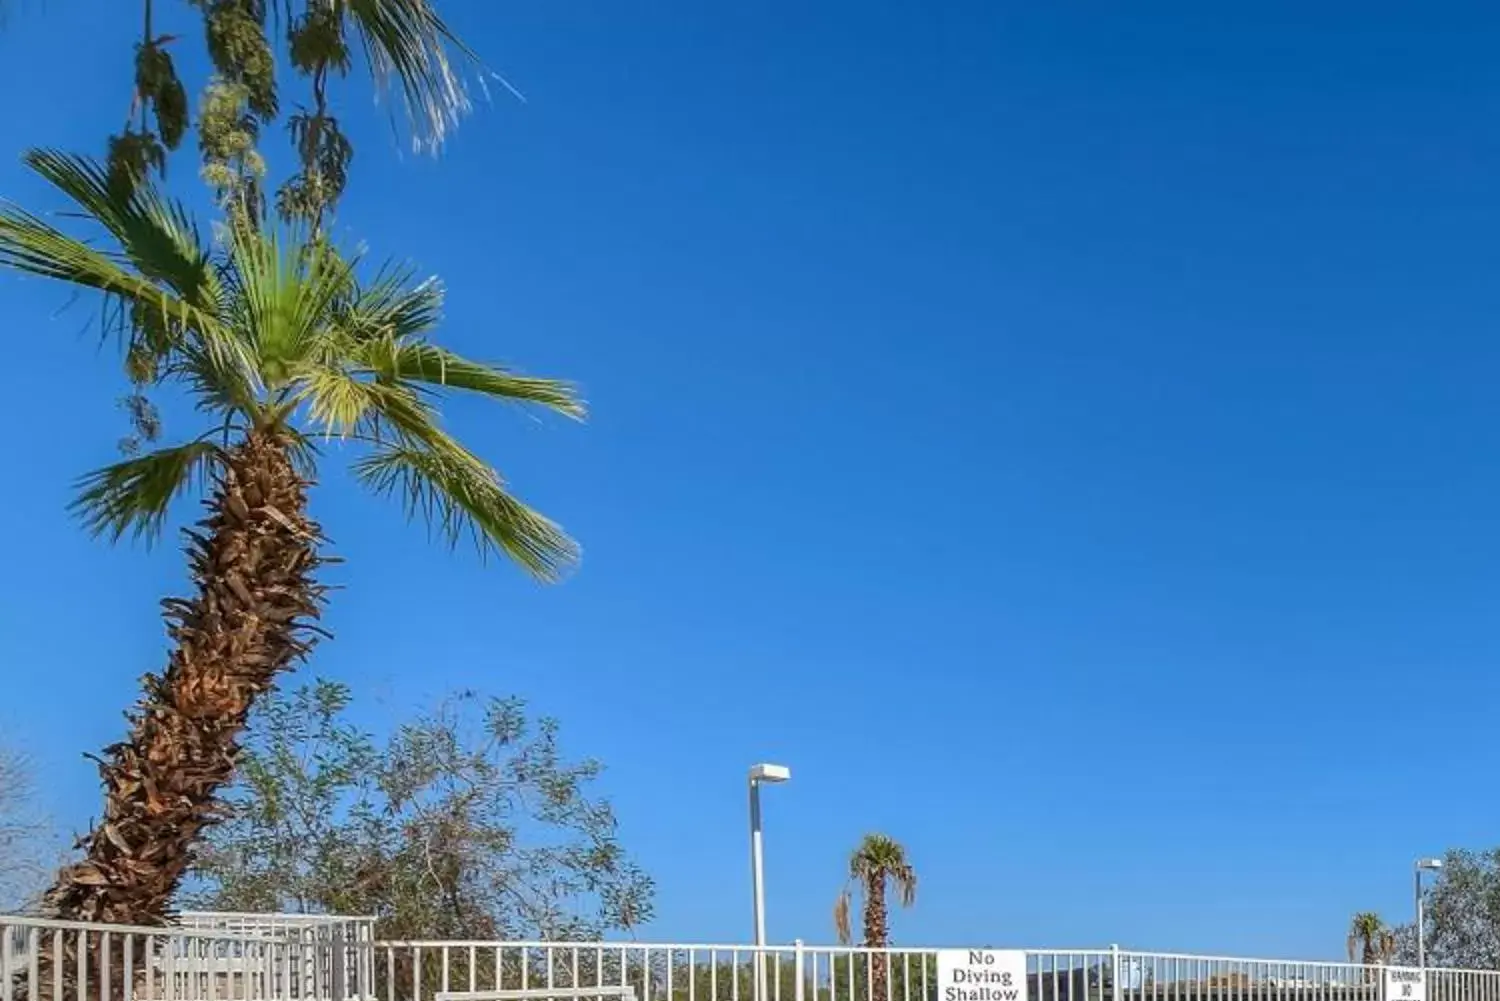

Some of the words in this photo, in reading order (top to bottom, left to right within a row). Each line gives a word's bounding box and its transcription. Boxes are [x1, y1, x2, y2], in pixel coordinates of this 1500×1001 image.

[969, 951, 995, 965] No
[953, 968, 1012, 987] Diving
[945, 987, 1019, 1001] Shallow
